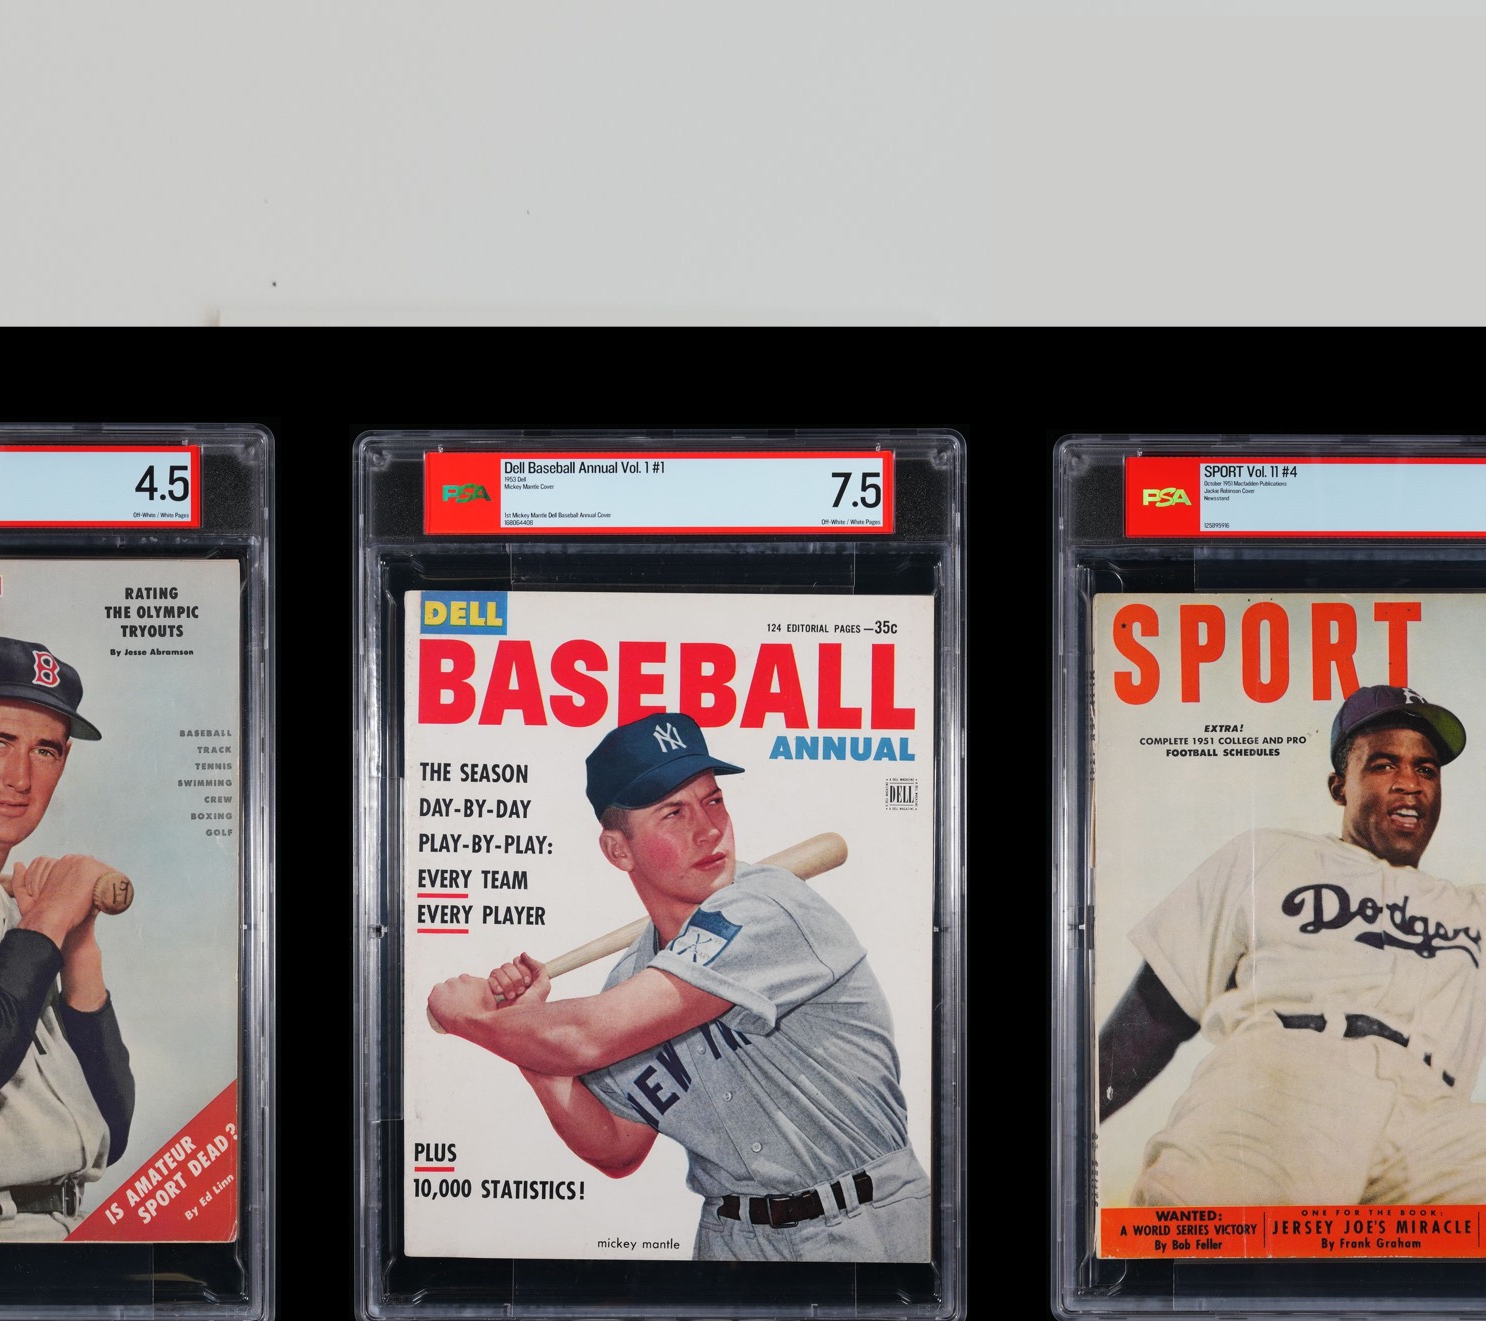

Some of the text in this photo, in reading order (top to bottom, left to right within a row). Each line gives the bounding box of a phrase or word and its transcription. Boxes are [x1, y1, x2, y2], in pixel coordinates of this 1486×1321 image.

[504, 461, 665, 474] Dell Baseball Annual Vol. 1 #1
[1204, 465, 1298, 478] SPORT Vol. 11 #4
[135, 465, 190, 502] 4.5
[504, 483, 522, 491] Mickey
[831, 472, 882, 509] 7.5
[441, 483, 492, 504] PSA
[1142, 487, 1192, 508] PSA
[124, 586, 179, 601] RATING
[104, 605, 200, 620] THE OLYMPIC
[424, 601, 504, 628] DELL
[120, 624, 185, 639] TRYOUTS
[766, 623, 861, 634] 124 EDITORIAL PAGES
[109, 647, 195, 658] By Jesse Abramson
[1113, 602, 1422, 705] SPORT
[417, 639, 915, 730] BASEBALL
[178, 728, 233, 738] BASEBALL
[1203, 724, 1245, 734] EXTRA!
[769, 735, 916, 762] ANNUAL
[1139, 736, 1307, 746] COMPLETE 1951 COLLEGE AND PRO
[197, 745, 233, 755] TRACK
[1166, 748, 1281, 758] FOOTBALL SCHEDULES
[195, 761, 233, 771] TENNIS
[419, 762, 529, 784] THE SEASON
[177, 778, 234, 788] SWIMMING
[204, 795, 233, 805] CREW
[889, 785, 915, 803] DELL
[189, 811, 234, 821] BOXING
[419, 798, 532, 820] DAY-BY-DAY
[205, 828, 234, 838] GOLF
[418, 834, 553, 854] PLAY-BY-PLAY:
[417, 868, 528, 890] EVERY TEAM
[417, 904, 546, 926] EVERY PLAYER
[1281, 883, 1482, 953] Dodgers
[414, 1142, 457, 1163] PLUS
[104, 1135, 197, 1225] IS AMATEUR
[184, 1174, 235, 1221] By Ed Linn
[413, 1179, 586, 1201] 10,000 STATISTICS!
[137, 1171, 187, 1225] SPORT
[1155, 1210, 1223, 1222] WANTED:
[1301, 1209, 1327, 1217] ONE
[1400, 1209, 1443, 1217] BOOK:
[1120, 1224, 1257, 1237] A WORLD SERIES VICTORY
[1272, 1220, 1472, 1235] JERSEY JOE'S MIRACLE
[597, 1237, 680, 1252] mickey mantle
[1154, 1238, 1223, 1253] By Bob Feller
[1321, 1237, 1422, 1252] By Frank Graham
